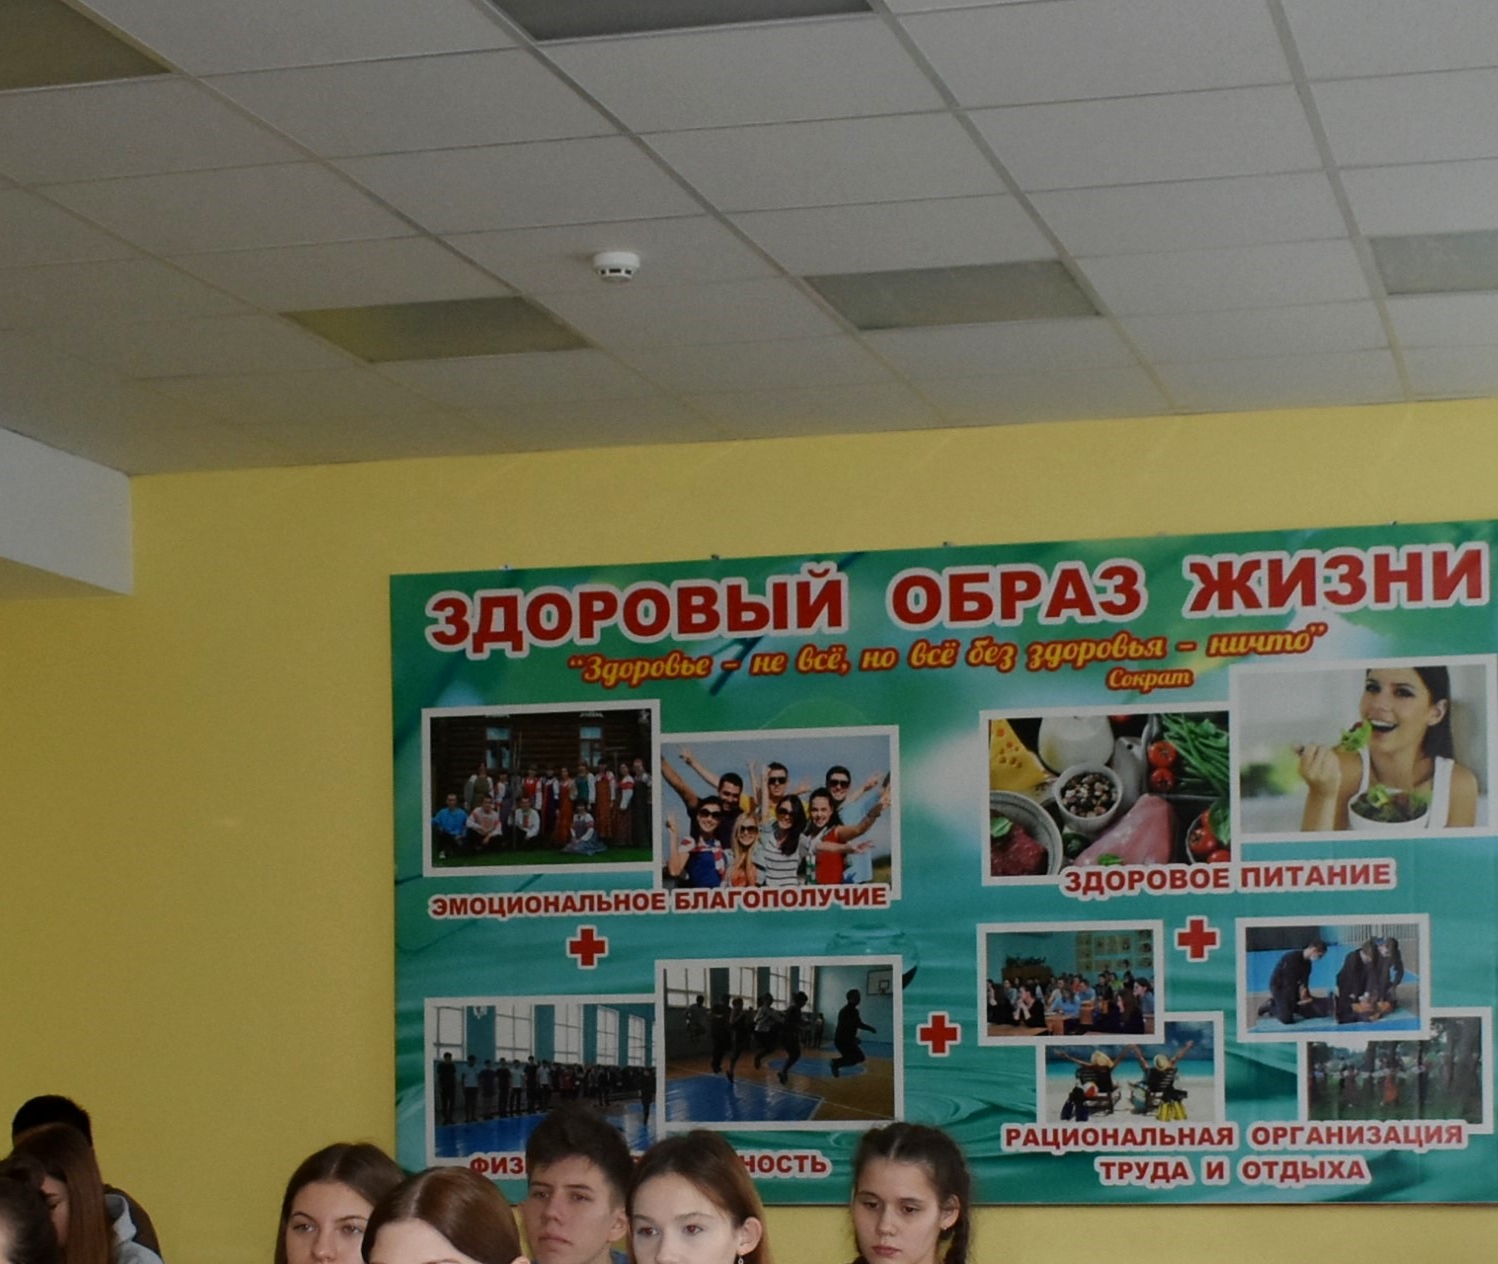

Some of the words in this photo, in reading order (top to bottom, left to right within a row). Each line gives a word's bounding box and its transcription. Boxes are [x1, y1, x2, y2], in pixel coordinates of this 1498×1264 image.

[427, 563, 845, 656] ЗДОРОВЫЙ
[890, 563, 1142, 627] ОБРАЗ
[1187, 548, 1484, 613] ЖИЗНИ
[750, 652, 786, 675] не
[798, 643, 850, 675] всё,
[860, 646, 897, 671] но
[910, 637, 959, 668] всё
[966, 636, 1017, 672] без
[1026, 630, 1167, 669] здоровья
[1106, 667, 1194, 693] Сократ
[1063, 867, 1231, 896] ЗДОРОВОЕ
[1240, 863, 1392, 889] ПИТАНИЕ
[430, 891, 666, 918] ЭМОЦИОНАЛЬНОЕ
[674, 887, 888, 912] БЛАГОПОЛУЧИЕ
[1004, 1126, 1235, 1152] РАЦИОНАЛЬНАЯ
[1251, 1124, 1464, 1150] ОРГАНИЗАЦИЯ
[469, 1154, 527, 1177] ФИЗ
[740, 1154, 828, 1174] НОСТЬ
[1099, 1160, 1189, 1184] ТРУДА
[1206, 1160, 1226, 1180] И
[1241, 1159, 1367, 1184] ОТДЫХА
